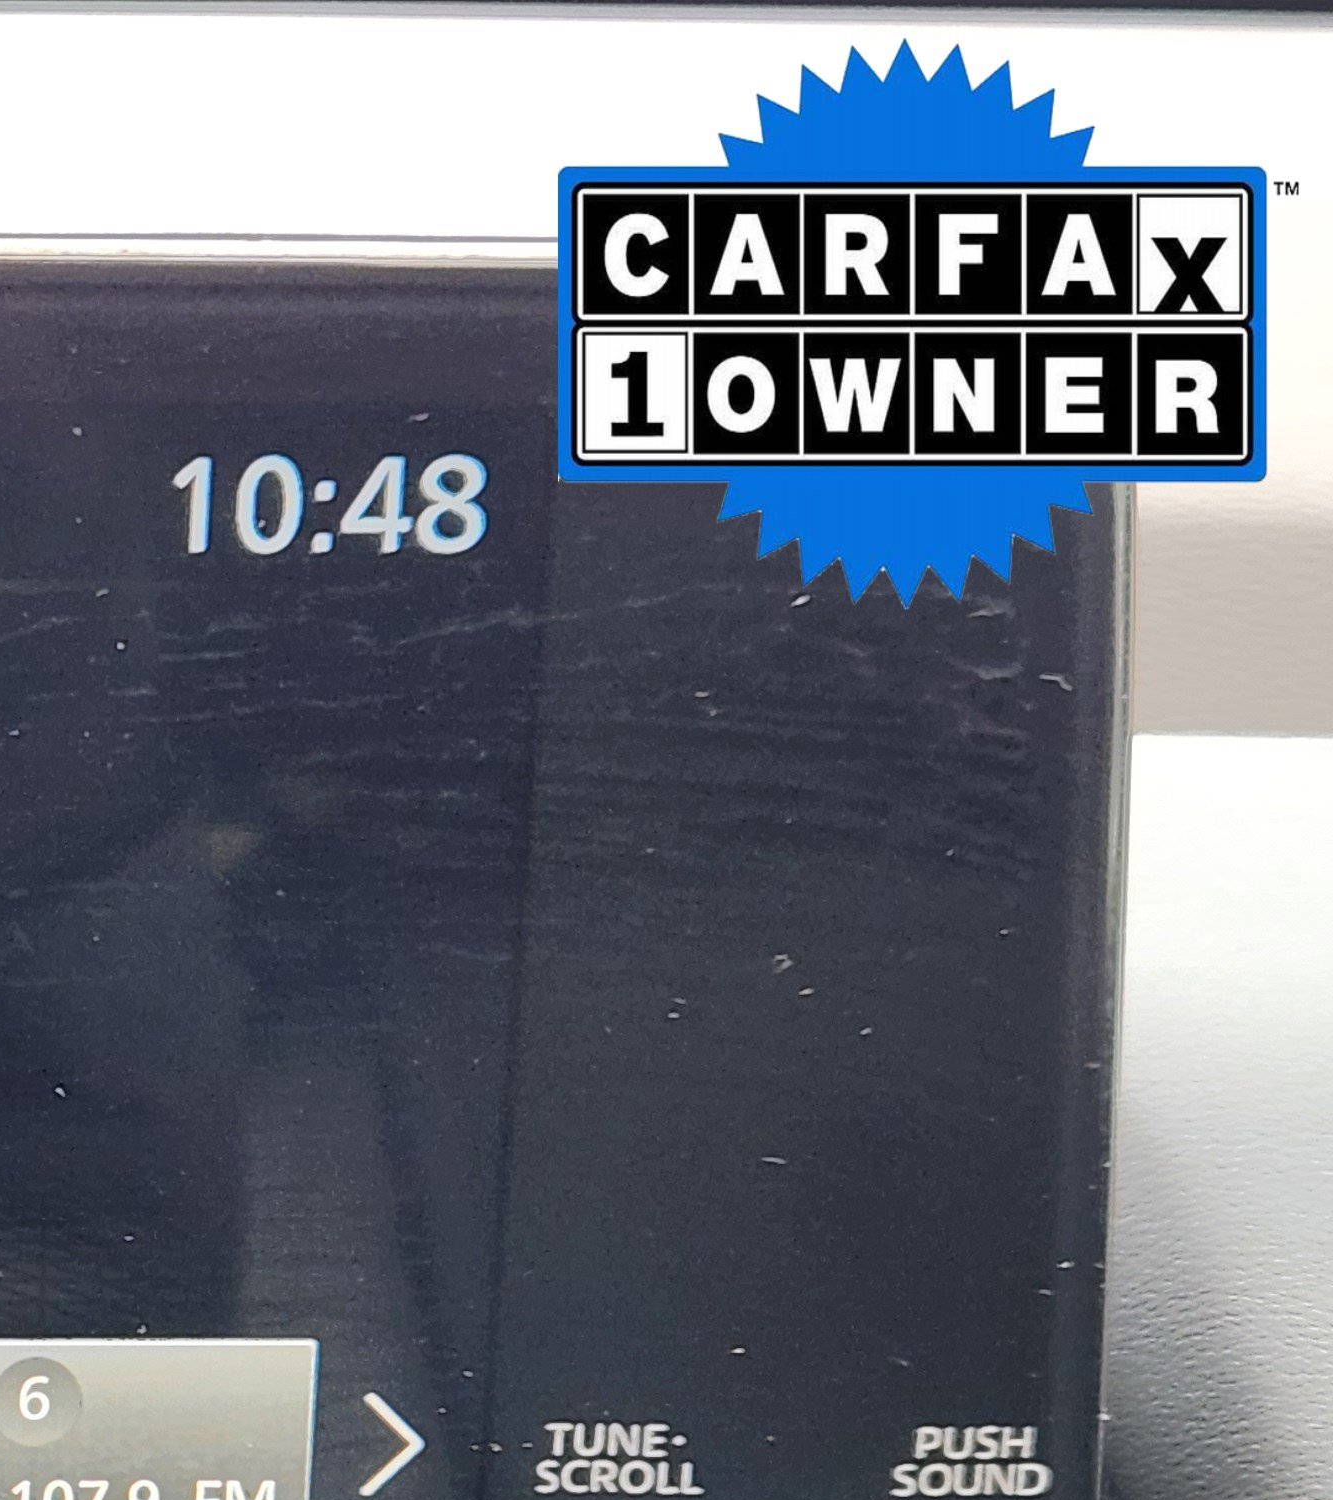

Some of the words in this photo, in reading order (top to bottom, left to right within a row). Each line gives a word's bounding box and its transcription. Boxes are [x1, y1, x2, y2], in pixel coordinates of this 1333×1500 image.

[171, 452, 488, 556] 10:48
[18, 1374, 51, 1422] 6
[912, 1424, 1038, 1461] PUSH
[532, 1457, 706, 1497] SCROLL
[888, 1461, 1053, 1499] SOUND
